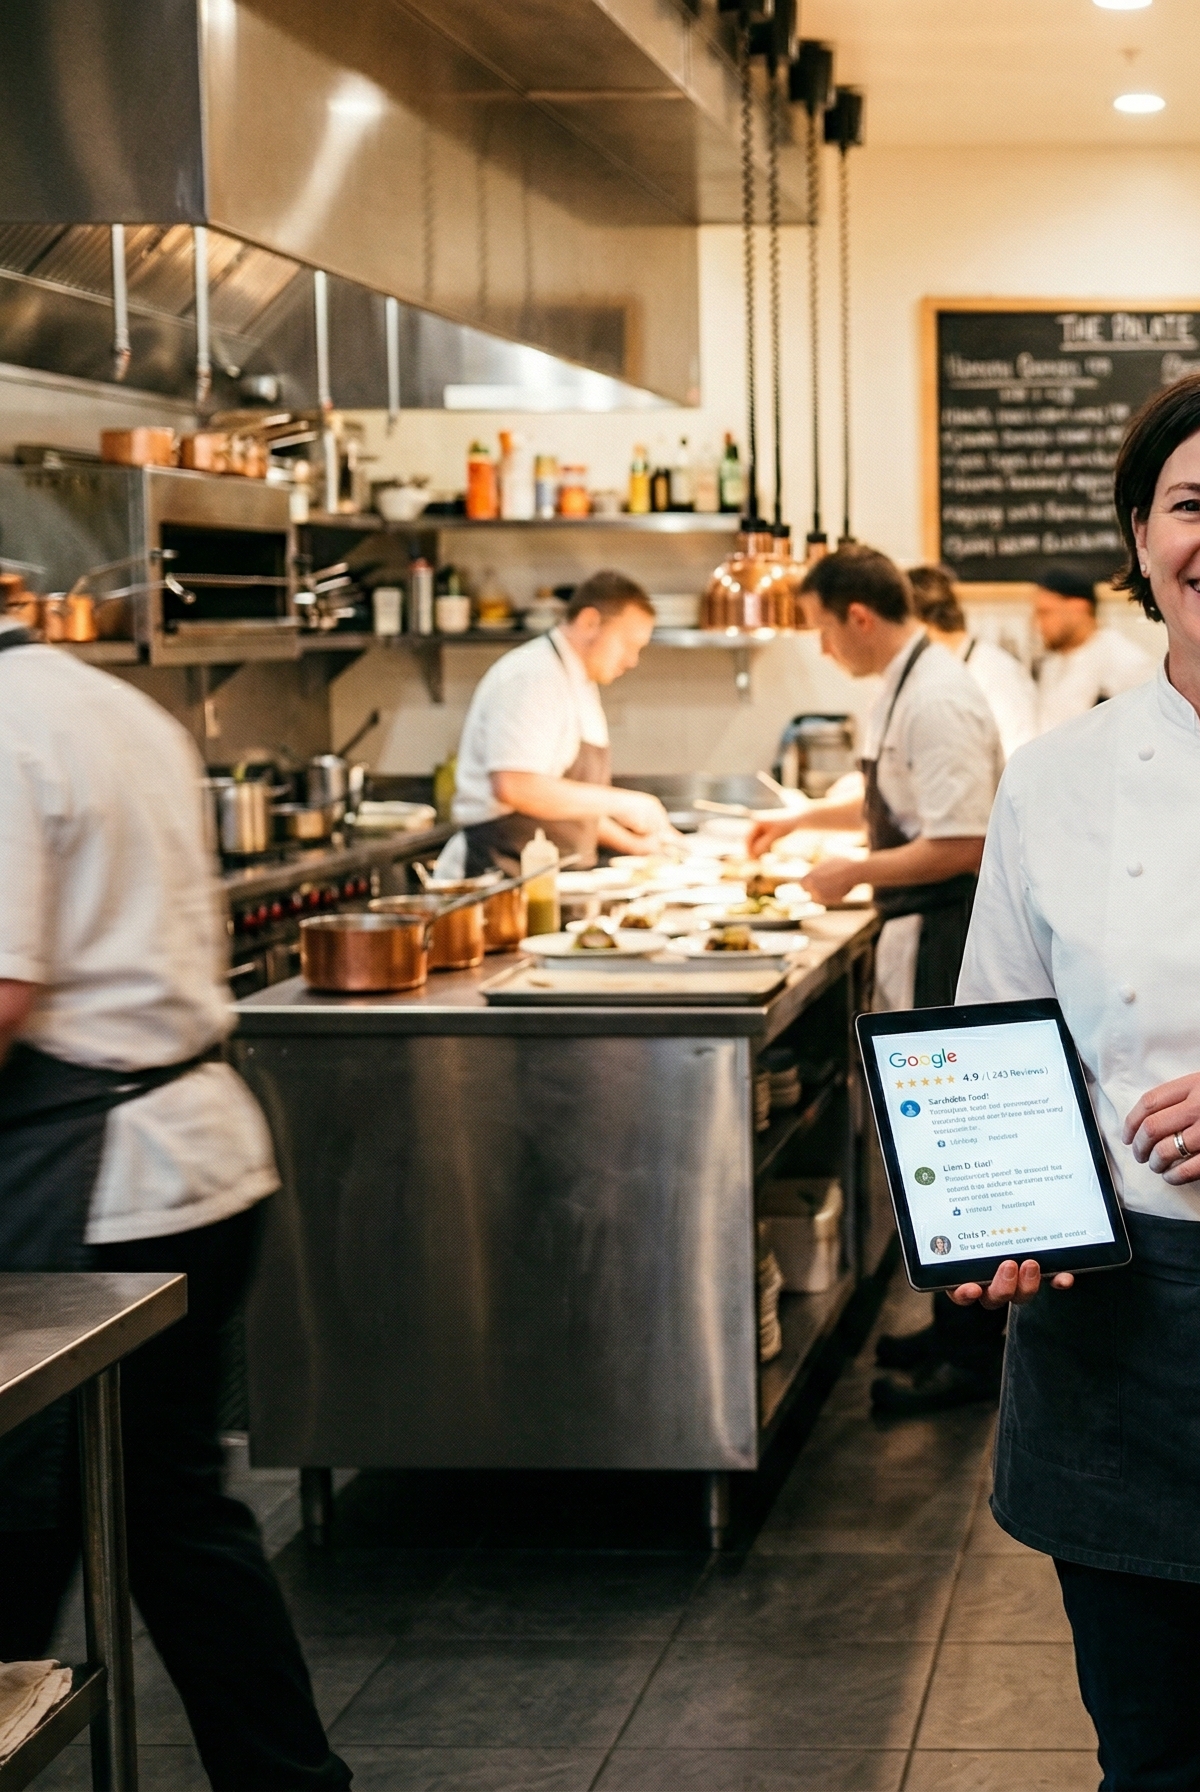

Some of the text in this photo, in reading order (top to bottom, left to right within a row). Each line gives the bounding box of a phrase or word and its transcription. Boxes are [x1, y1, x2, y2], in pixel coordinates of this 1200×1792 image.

[1055, 313, 1105, 342] THE
[889, 1048, 957, 1068] Google
[962, 1072, 979, 1082] 4.9
